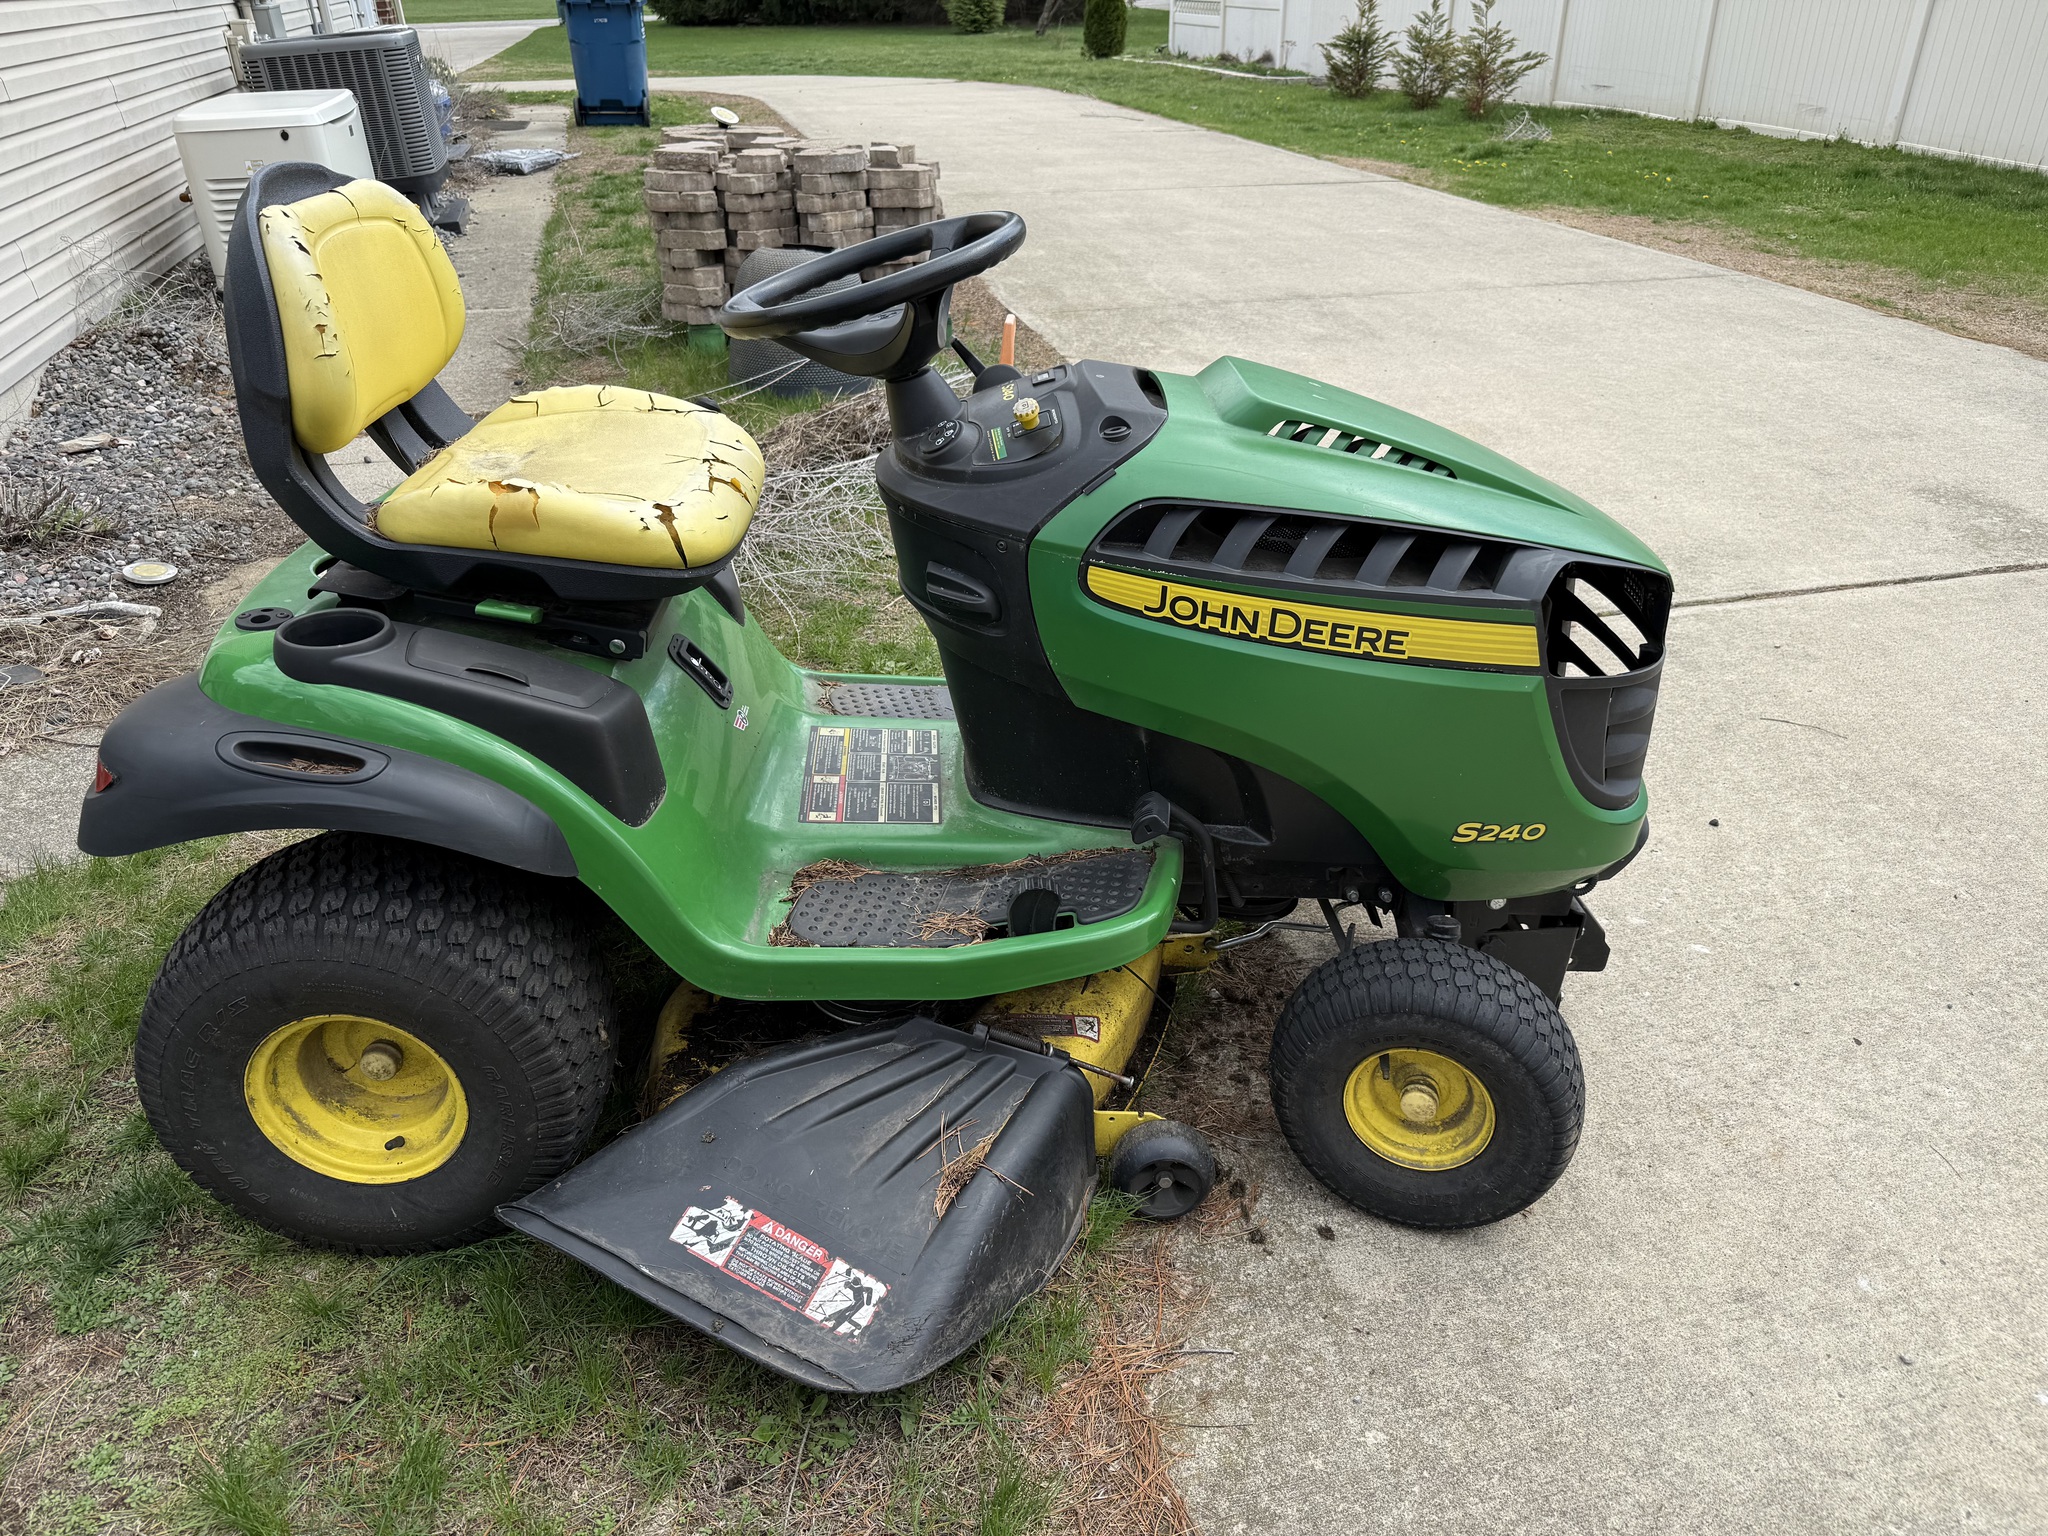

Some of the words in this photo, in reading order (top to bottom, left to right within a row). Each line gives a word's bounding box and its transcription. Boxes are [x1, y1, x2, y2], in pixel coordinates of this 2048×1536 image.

[1143, 585, 1260, 635] JOHN
[1267, 607, 1410, 655] DEERE
[1451, 822, 1547, 843] S240
[482, 1065, 516, 1186] CARLISLE
[759, 1234, 790, 1253] ROTATING
[790, 1251, 812, 1265] BLADE
[774, 1226, 824, 1261] DANGER
[749, 1246, 777, 1264] THROWN
[776, 1261, 805, 1280] OBJECTS
